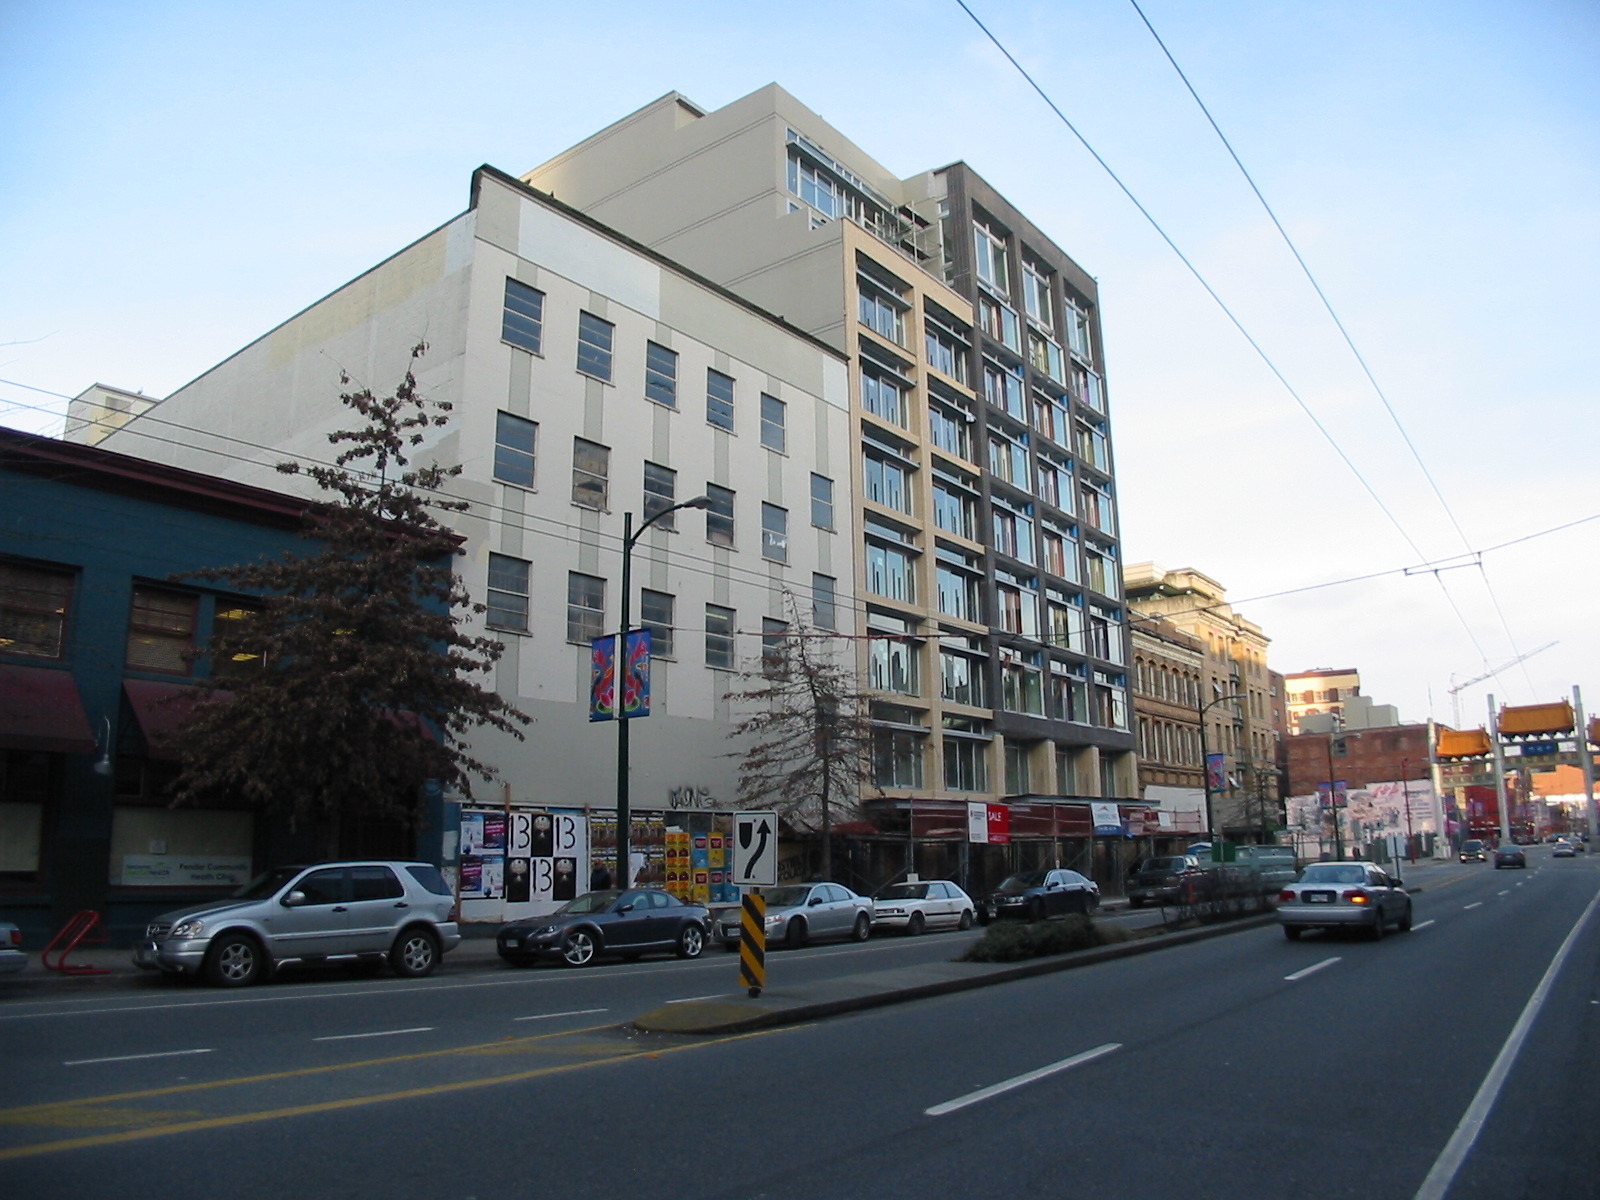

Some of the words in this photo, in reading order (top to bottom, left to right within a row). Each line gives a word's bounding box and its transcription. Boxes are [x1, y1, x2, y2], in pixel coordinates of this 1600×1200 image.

[511, 815, 530, 851] 13
[555, 816, 576, 851] 13
[532, 859, 552, 894] 13
